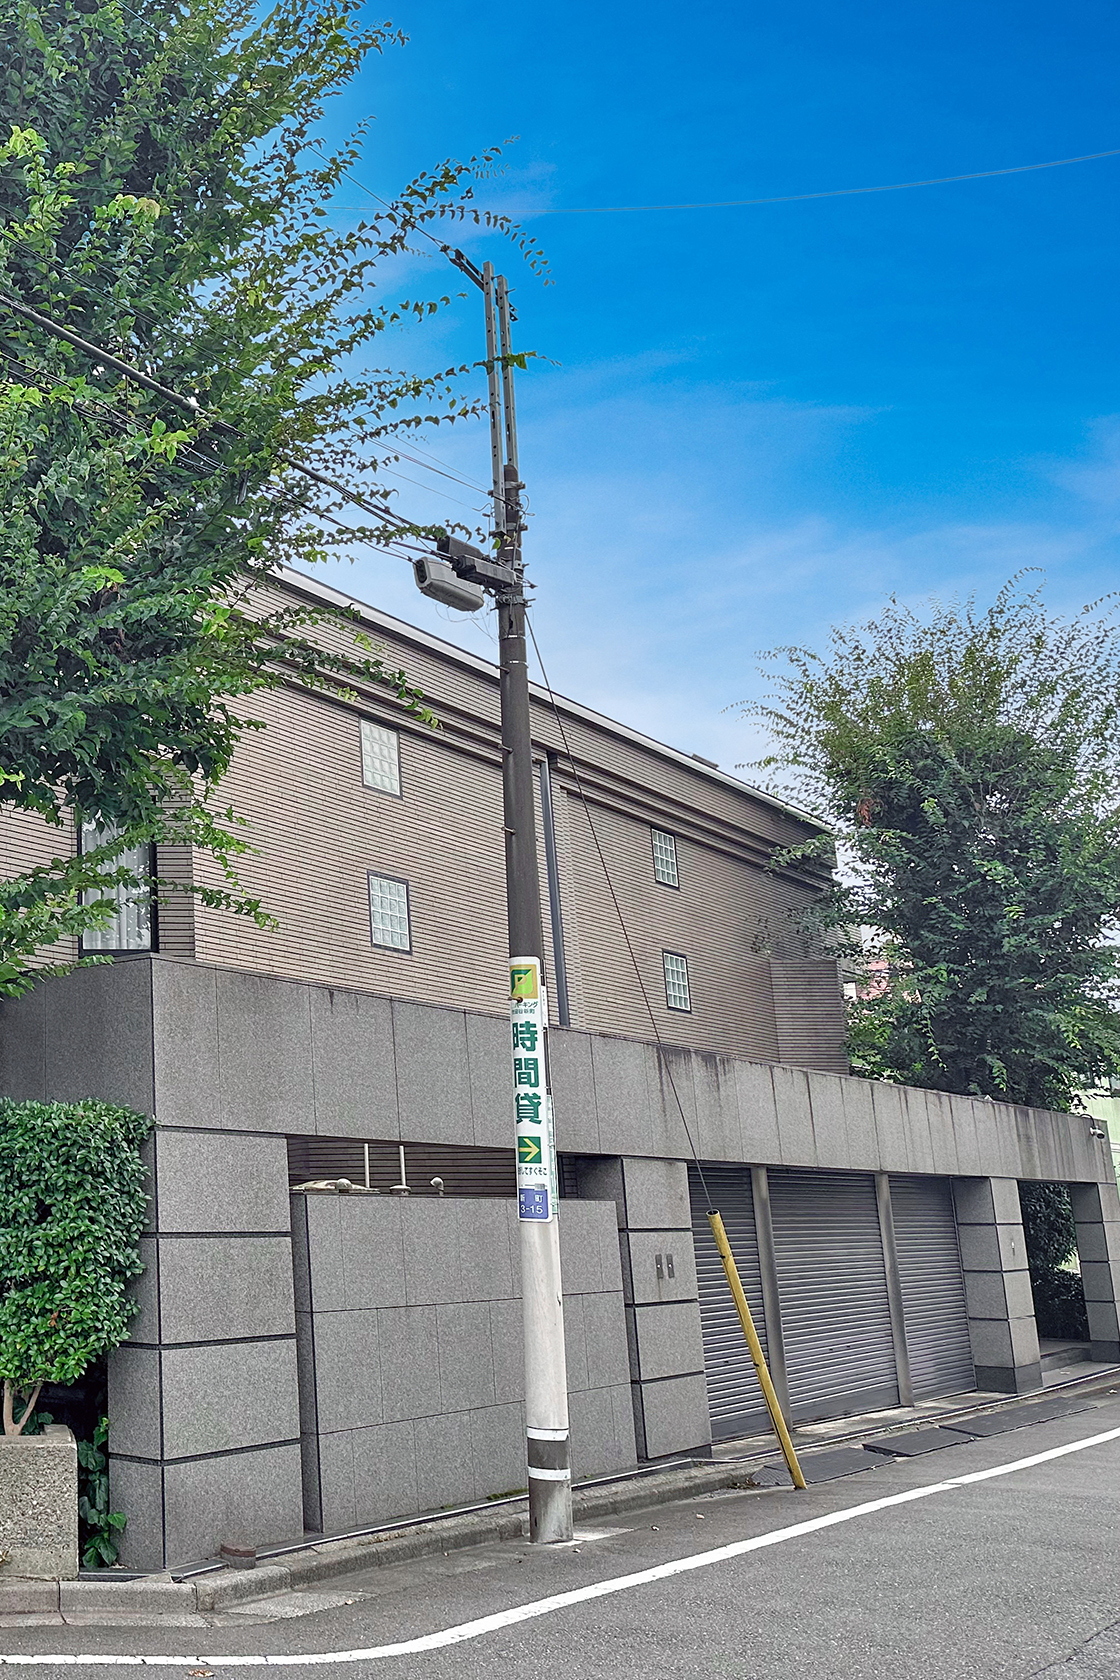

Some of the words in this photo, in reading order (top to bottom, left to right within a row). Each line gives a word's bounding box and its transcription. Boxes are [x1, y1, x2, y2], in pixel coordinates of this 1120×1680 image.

[512, 1021, 542, 1125] 時間貸
[520, 1205, 543, 1214] 3-15
